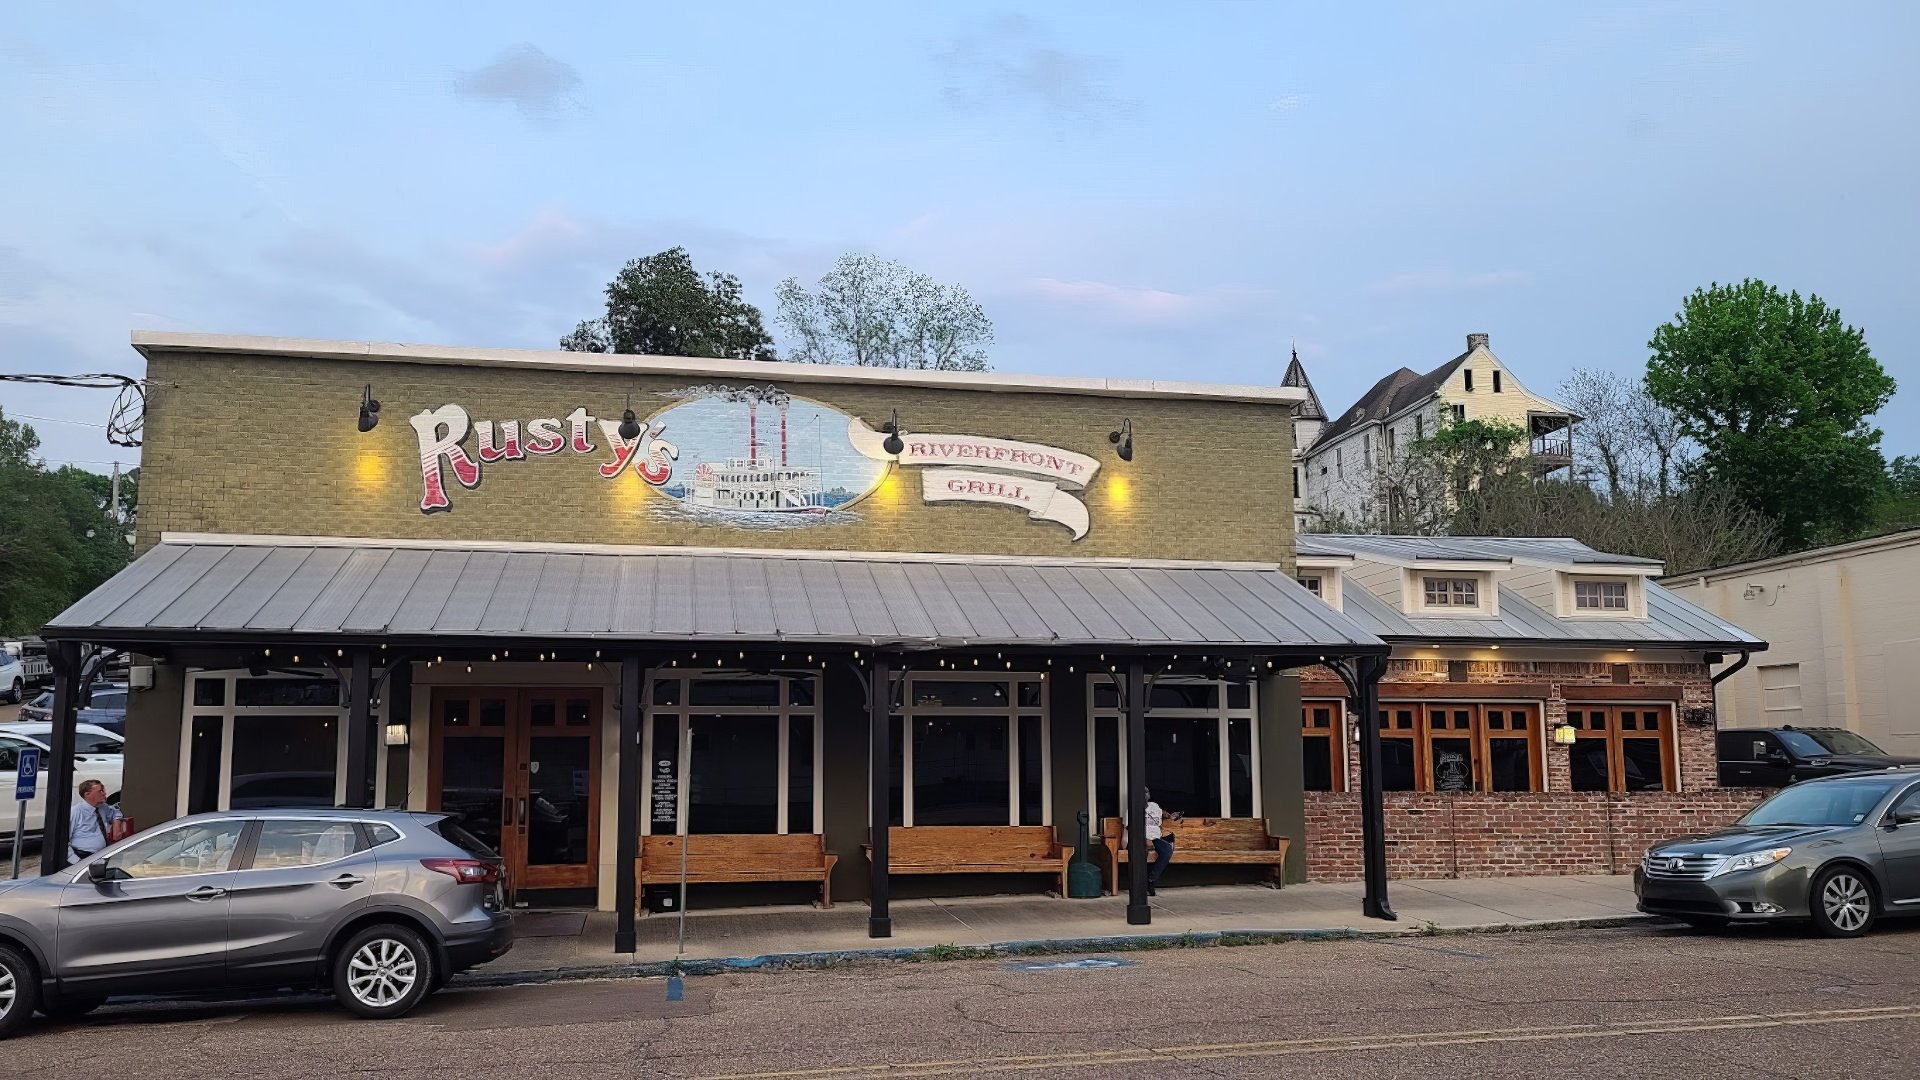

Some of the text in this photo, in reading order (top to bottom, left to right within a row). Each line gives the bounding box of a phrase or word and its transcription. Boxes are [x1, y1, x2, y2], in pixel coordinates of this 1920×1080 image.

[410, 403, 679, 514] Rusty's
[909, 443, 1084, 475] RIVERFRONT
[948, 479, 1031, 501] GRILL
